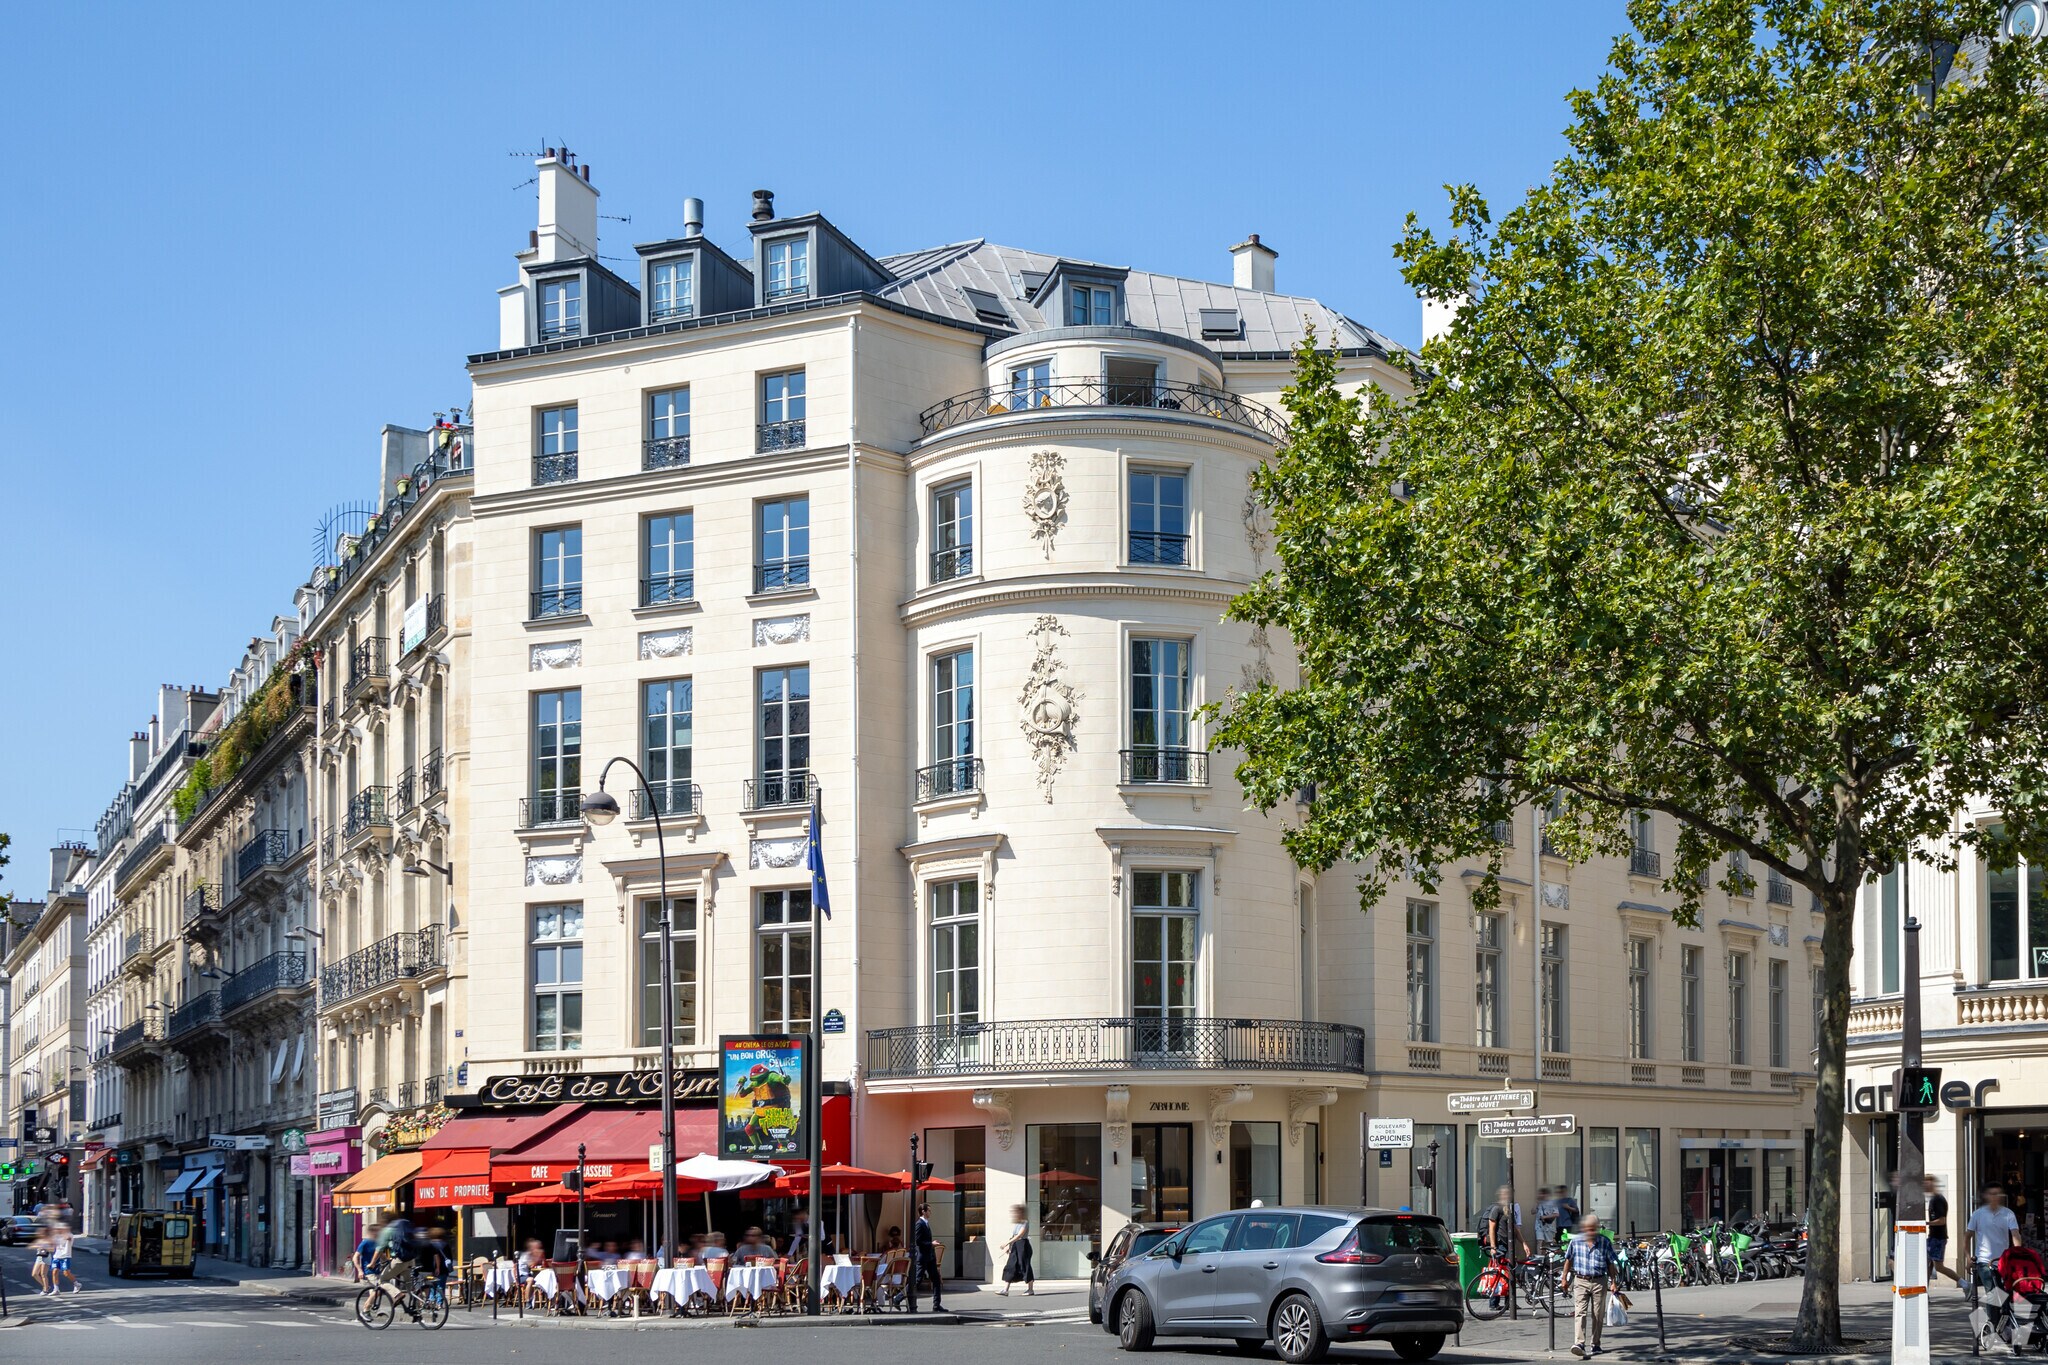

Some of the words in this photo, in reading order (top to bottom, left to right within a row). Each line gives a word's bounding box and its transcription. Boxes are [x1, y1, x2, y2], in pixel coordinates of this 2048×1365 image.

[740, 1052, 754, 1060] BON
[755, 1049, 777, 1060] GROS
[491, 1076, 565, 1104] Café
[570, 1076, 608, 1097] de
[1516, 1119, 1546, 1127] EDOUARD
[1369, 1134, 1412, 1142] CAPUCINES
[212, 1140, 235, 1148] DVD
[531, 1166, 549, 1178] CAFE
[577, 1165, 613, 1178] ASSERIE
[419, 1187, 435, 1199] VINS
[440, 1186, 448, 1198] DE
[454, 1184, 489, 1197] PROPRIETE
